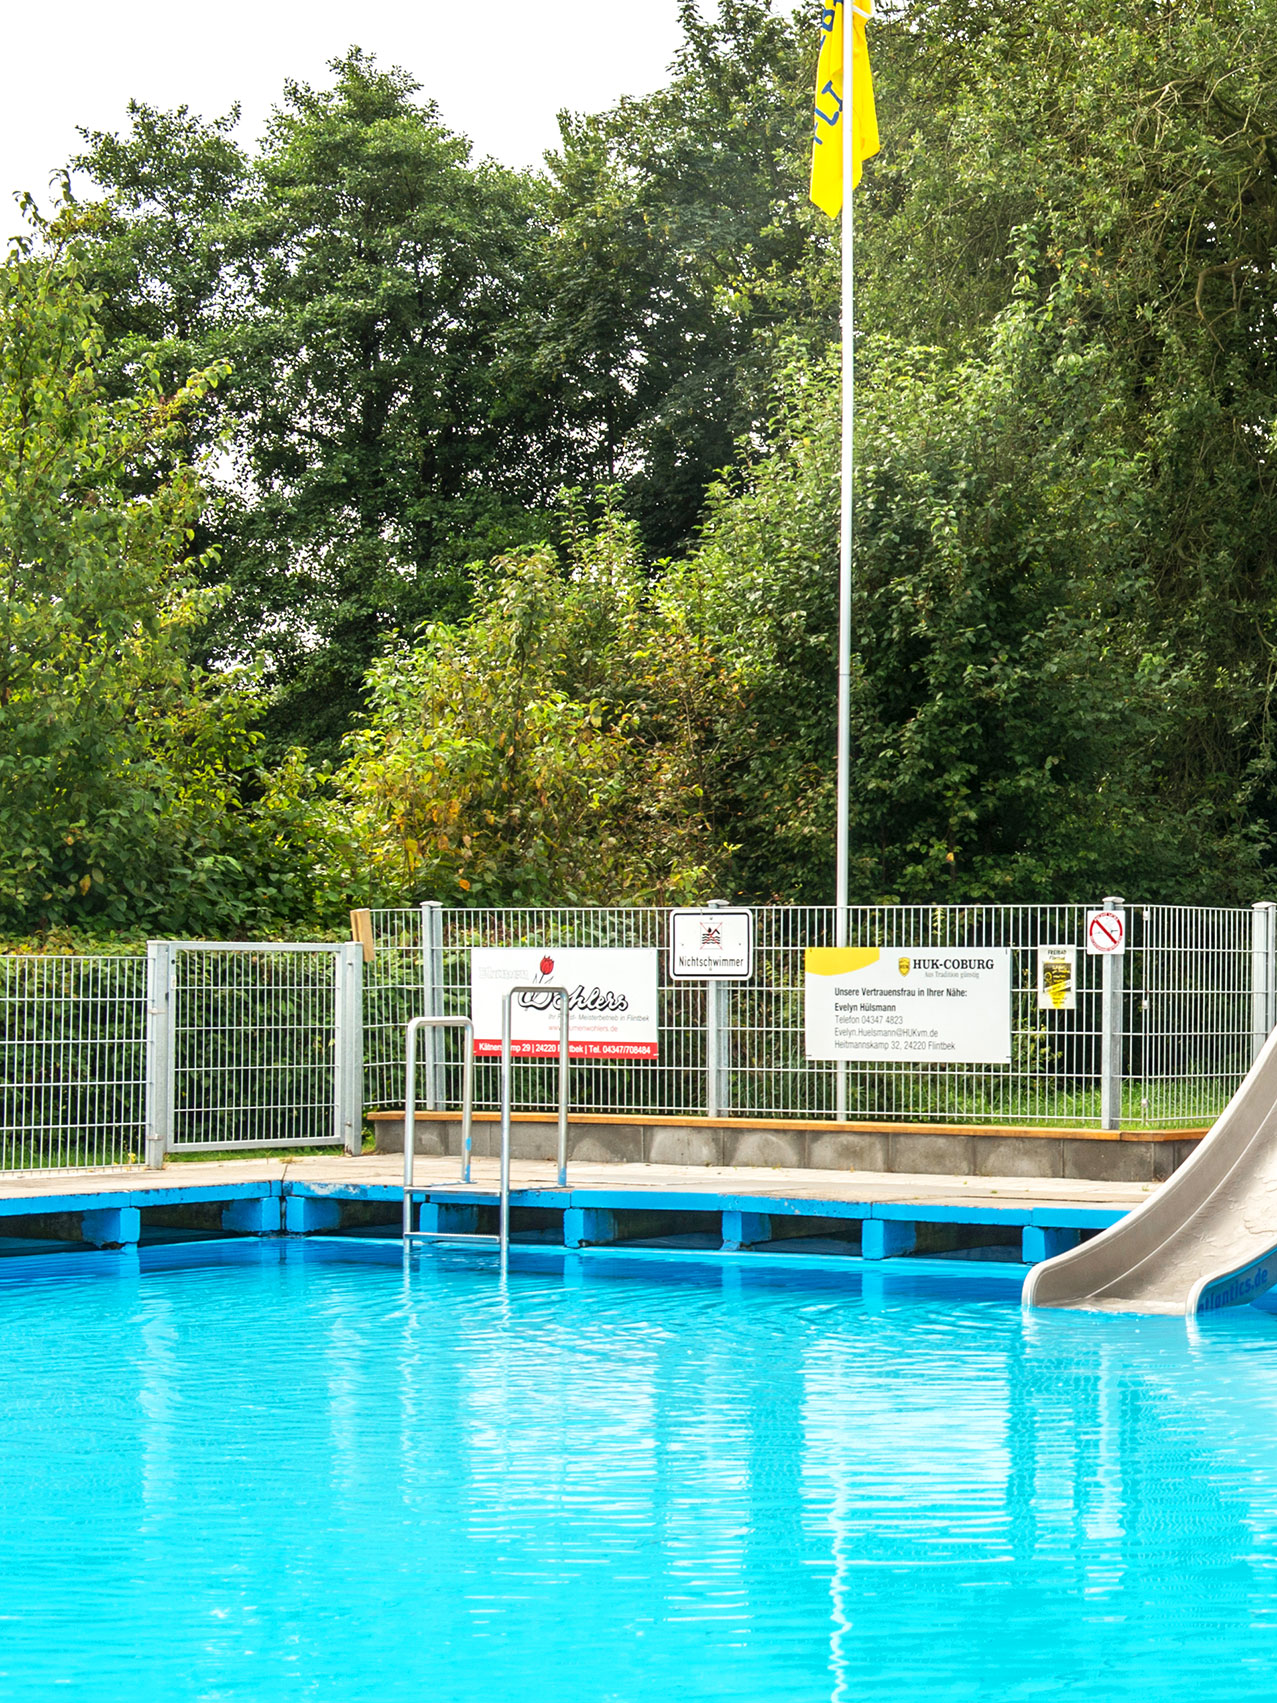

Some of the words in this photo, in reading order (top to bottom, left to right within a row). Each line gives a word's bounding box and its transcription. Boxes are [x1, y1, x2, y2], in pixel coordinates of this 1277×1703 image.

[678, 956, 745, 967] Nichtschwimmer
[913, 959, 995, 970] HUK-COBURG
[834, 987, 860, 997] Unsere
[861, 987, 916, 997] Vertrauensfrau
[917, 988, 925, 997] in
[926, 988, 944, 997] Ihrer
[946, 988, 968, 997] Nähe:
[834, 1002, 858, 1013] Evelyn
[859, 1002, 896, 1012] Hülsmann
[834, 1014, 860, 1024] Telefon
[861, 1015, 884, 1024] 04347
[885, 1015, 904, 1025] 4823
[521, 1044, 532, 1052] 29
[535, 1044, 557, 1053] 24220
[588, 1045, 601, 1053] Tel.
[904, 1041, 927, 1050] 24220
[928, 1041, 956, 1050] Flintbek
